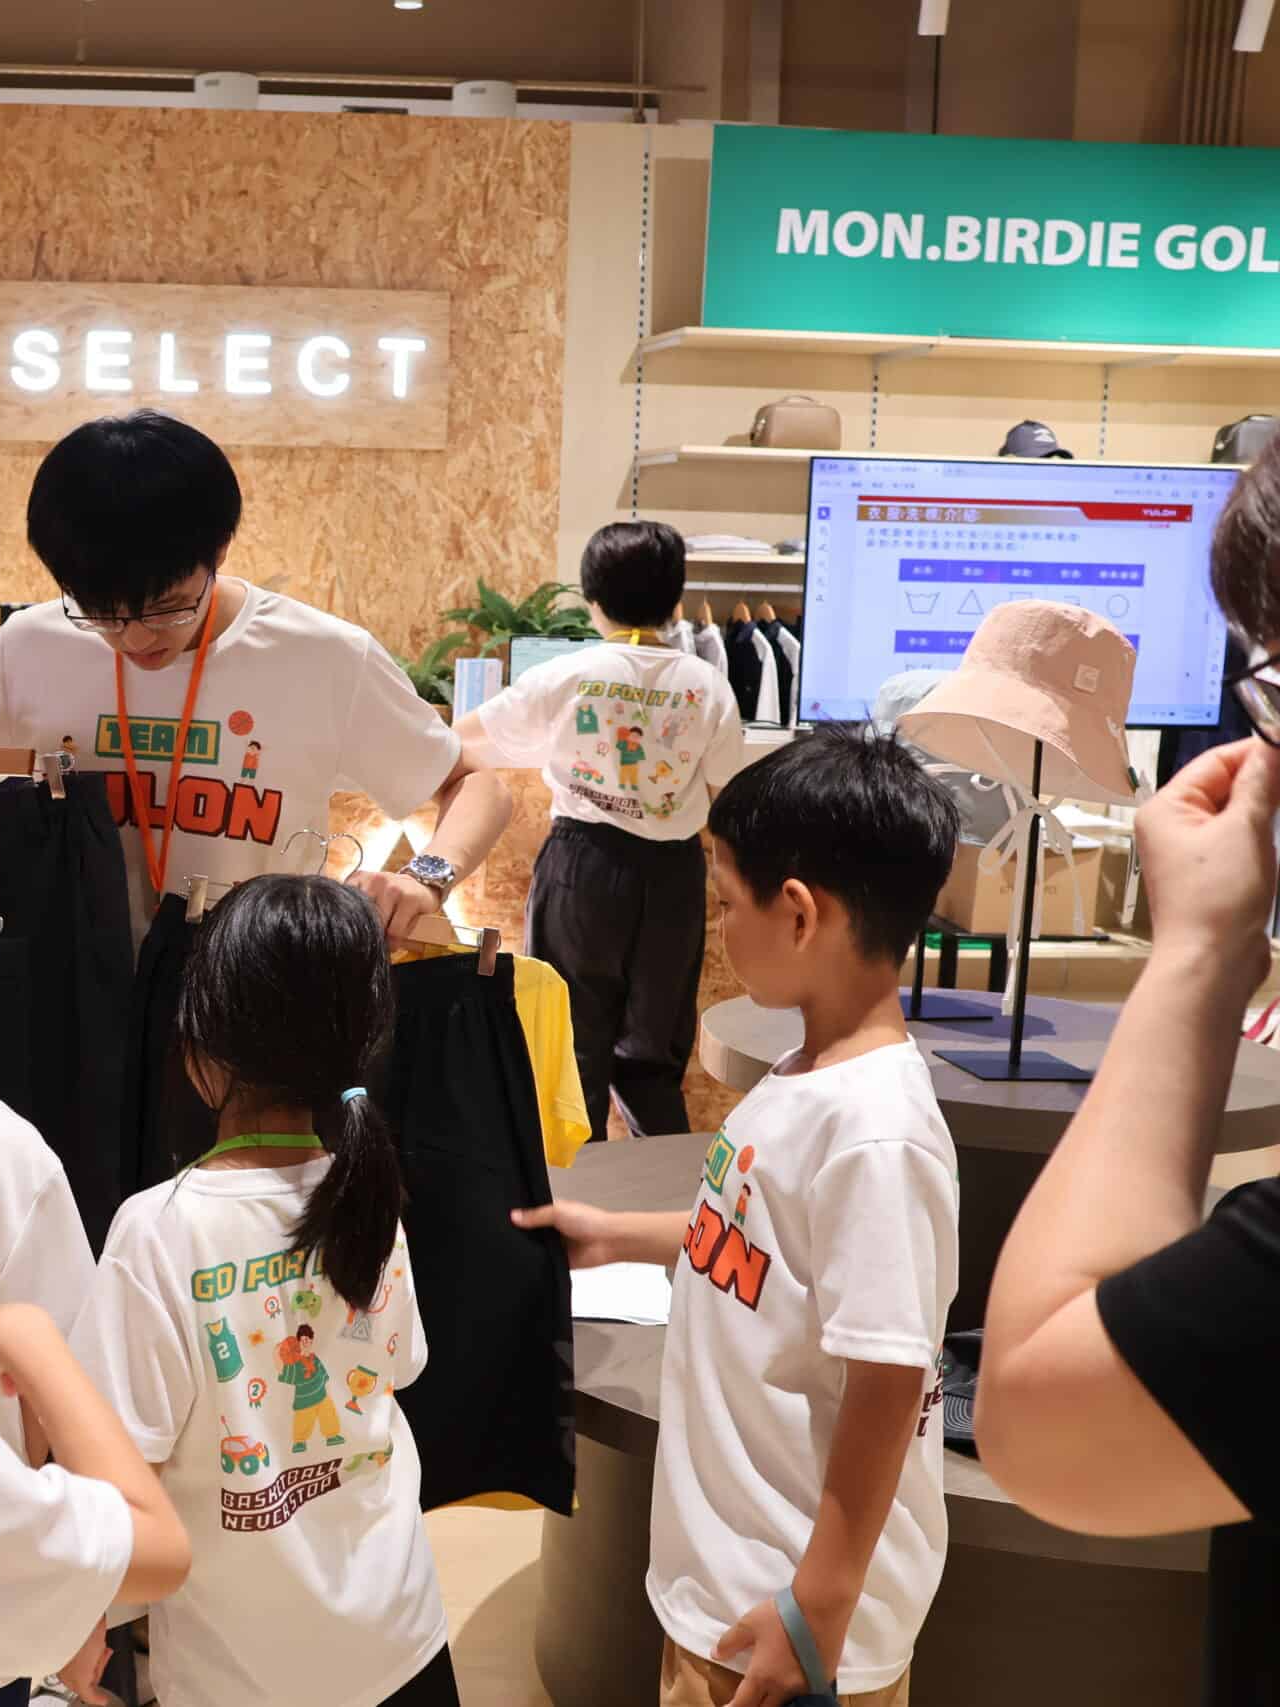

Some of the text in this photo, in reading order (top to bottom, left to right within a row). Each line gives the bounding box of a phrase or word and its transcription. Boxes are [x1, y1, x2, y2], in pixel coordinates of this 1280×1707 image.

[775, 207, 1280, 274] MON.BIRDIE GOL
[10, 329, 427, 398] SELECT
[192, 1262, 237, 1302] GO
[242, 1249, 306, 1293] FOR
[683, 1199, 772, 1312] ON
[216, 1341, 231, 1360] 2
